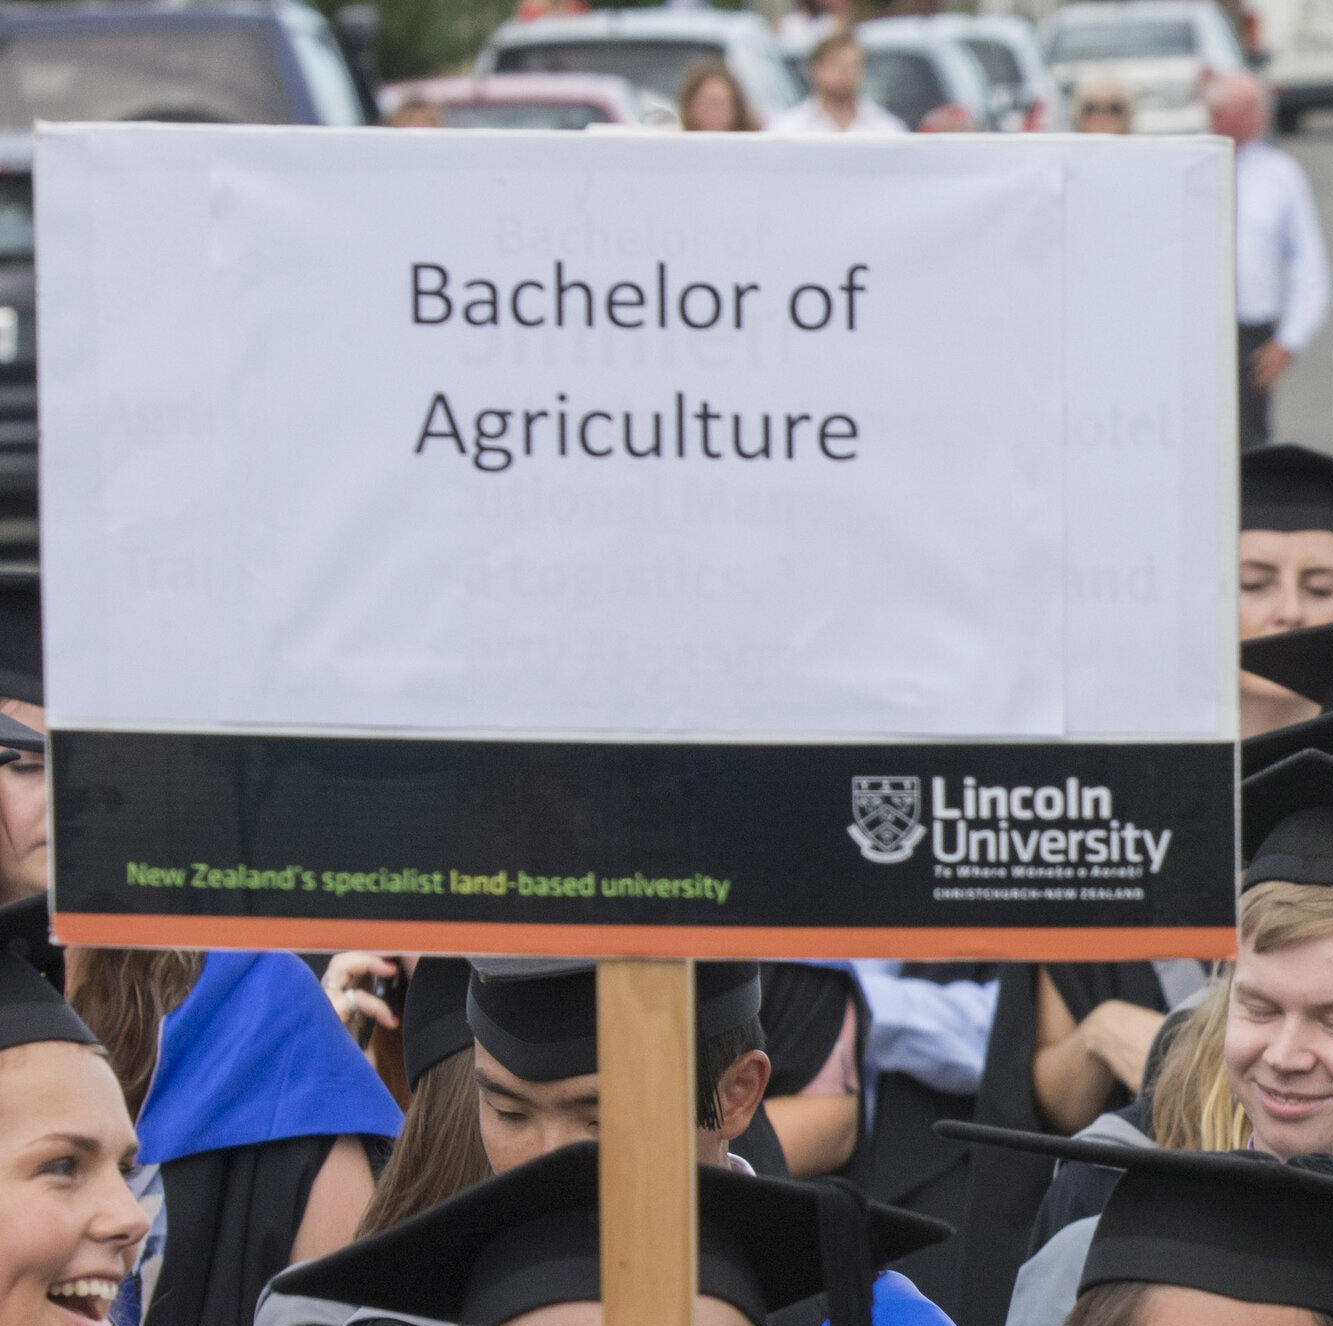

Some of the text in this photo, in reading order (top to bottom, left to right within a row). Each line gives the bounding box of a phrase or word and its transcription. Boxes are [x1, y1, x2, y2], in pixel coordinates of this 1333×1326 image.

[410, 260, 870, 331] Bachelor of
[412, 391, 861, 472] Agriculture
[932, 776, 1112, 820] Lincoln
[932, 819, 1173, 874] University
[126, 861, 732, 905] New Zealand's specialist land-based university
